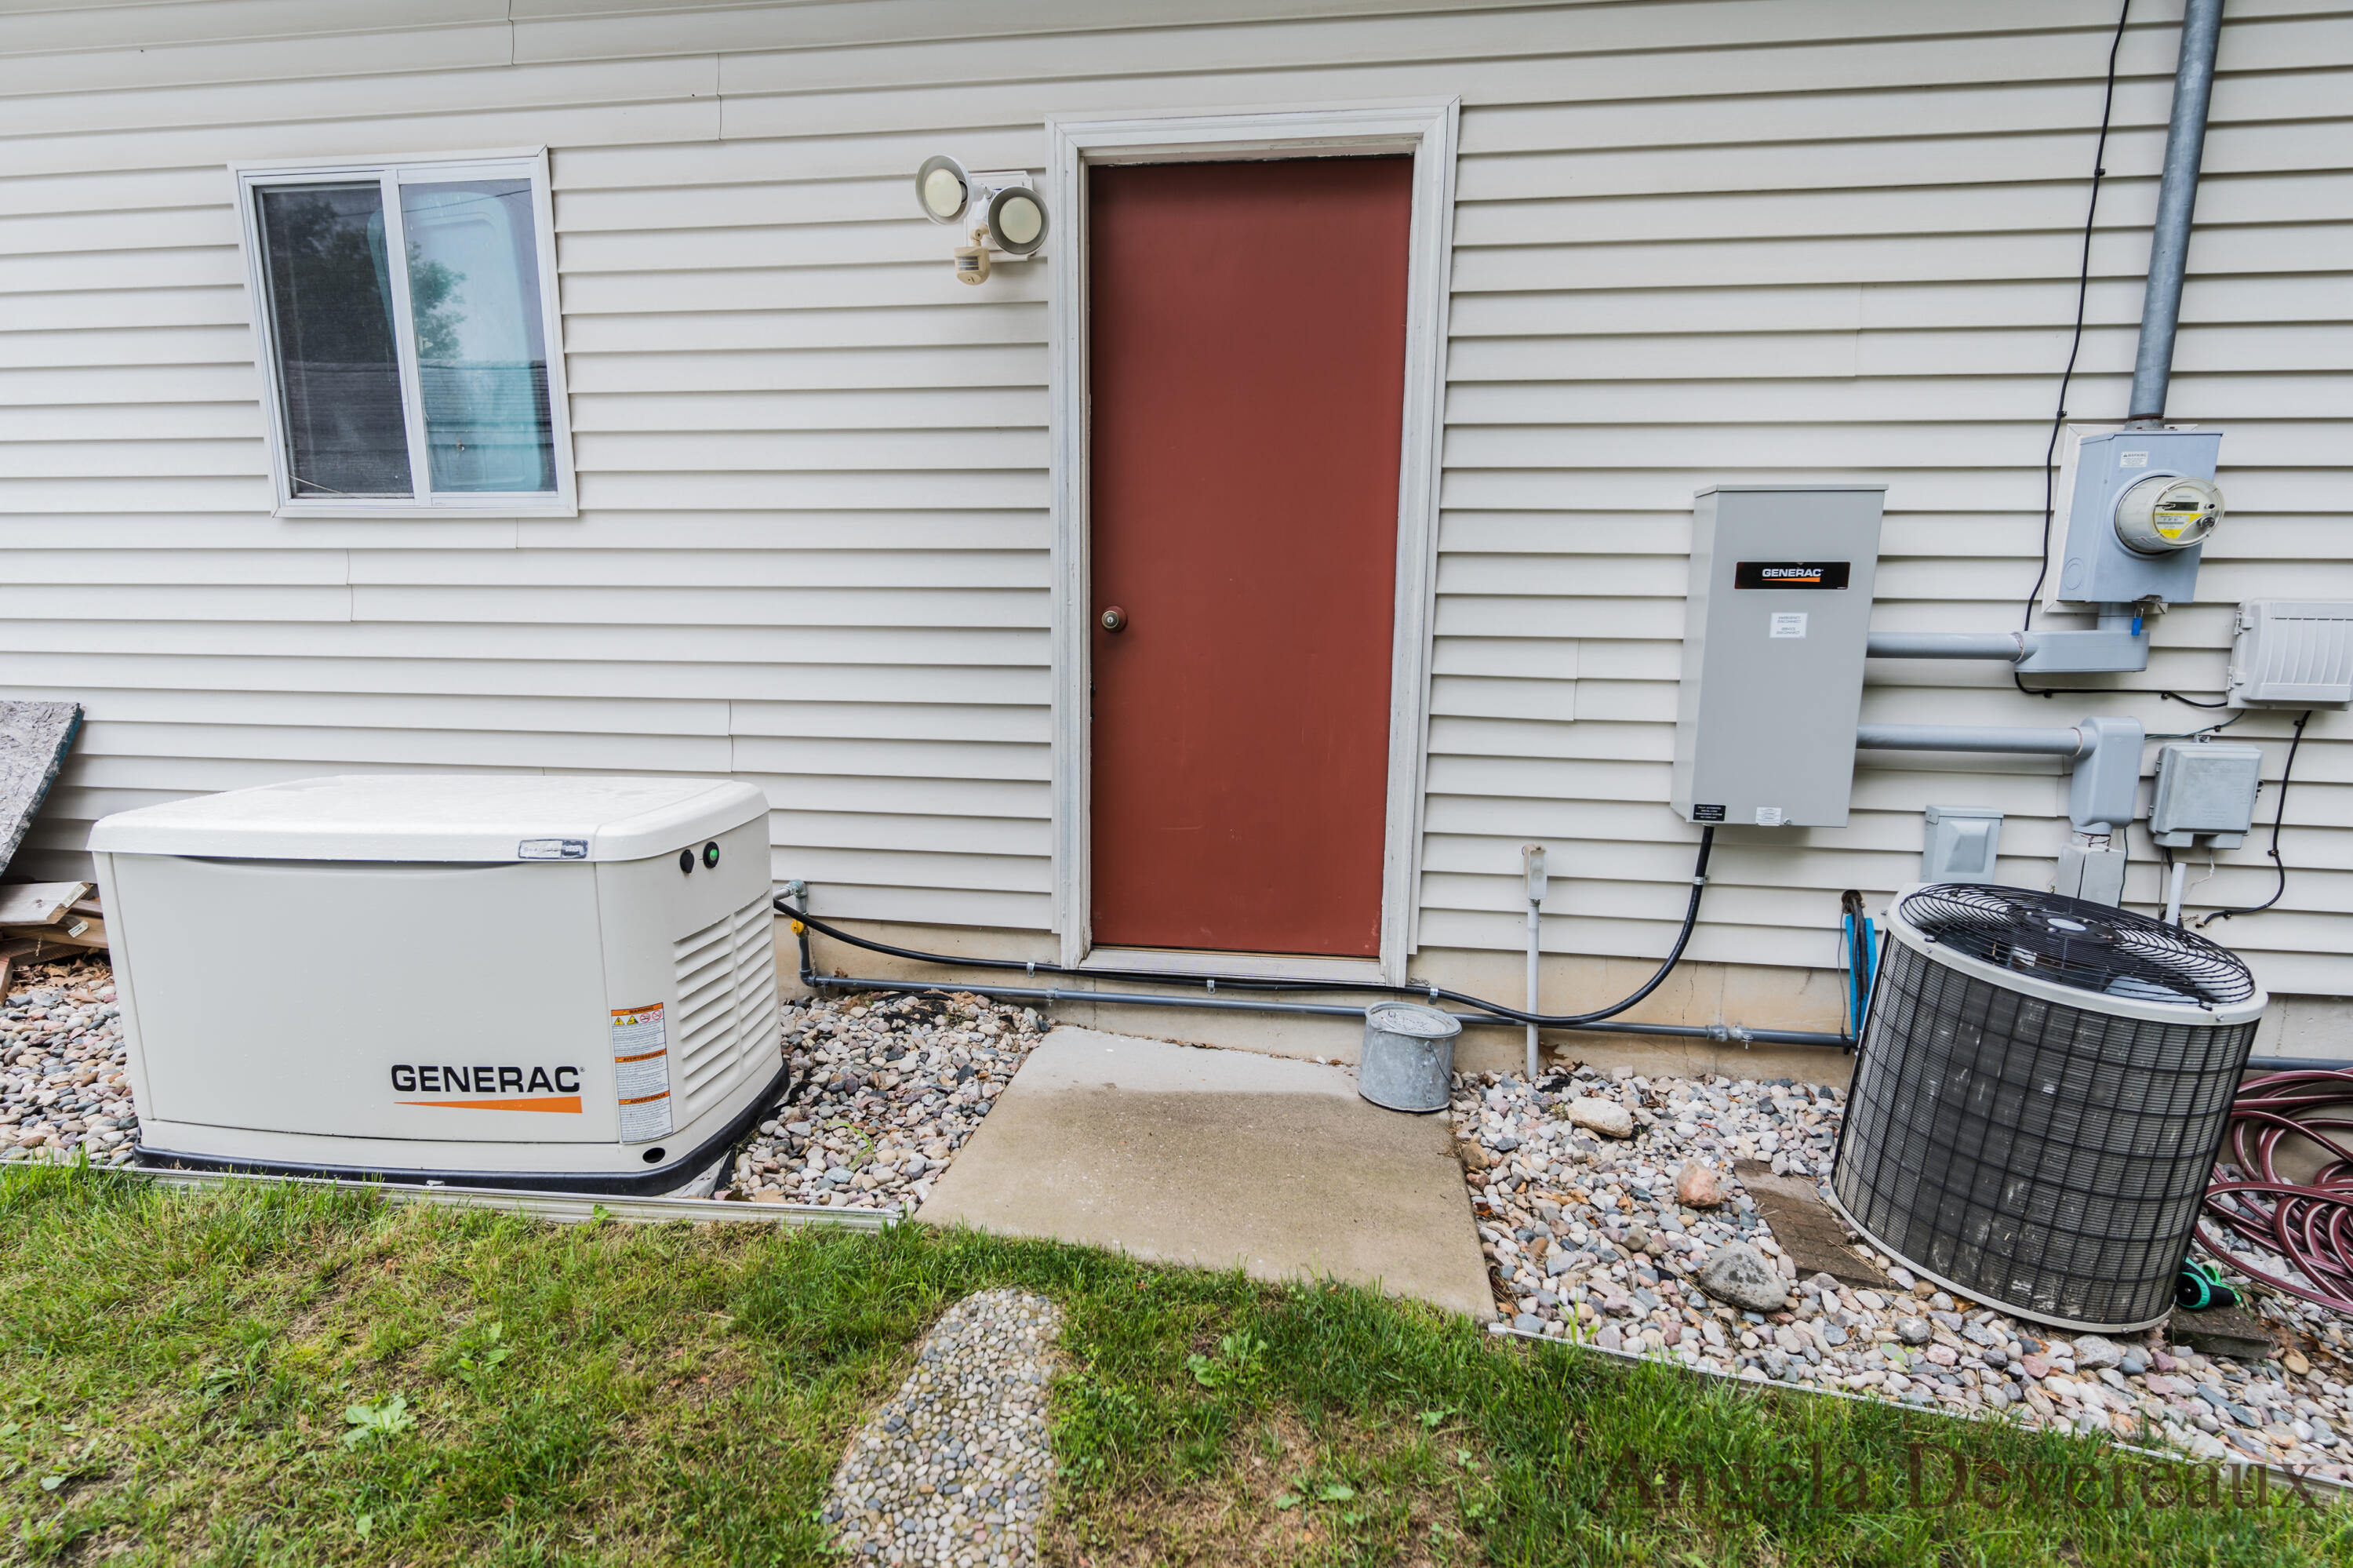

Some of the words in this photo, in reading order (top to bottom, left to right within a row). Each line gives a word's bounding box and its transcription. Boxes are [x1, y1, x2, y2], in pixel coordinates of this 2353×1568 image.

[1762, 568, 1821, 577] GENERAC
[629, 1006, 654, 1014] WARNING
[623, 1050, 665, 1061] AVERTISSEMENT
[391, 1064, 580, 1093] GENERAC
[630, 1093, 666, 1104] ADVERTENCIA
